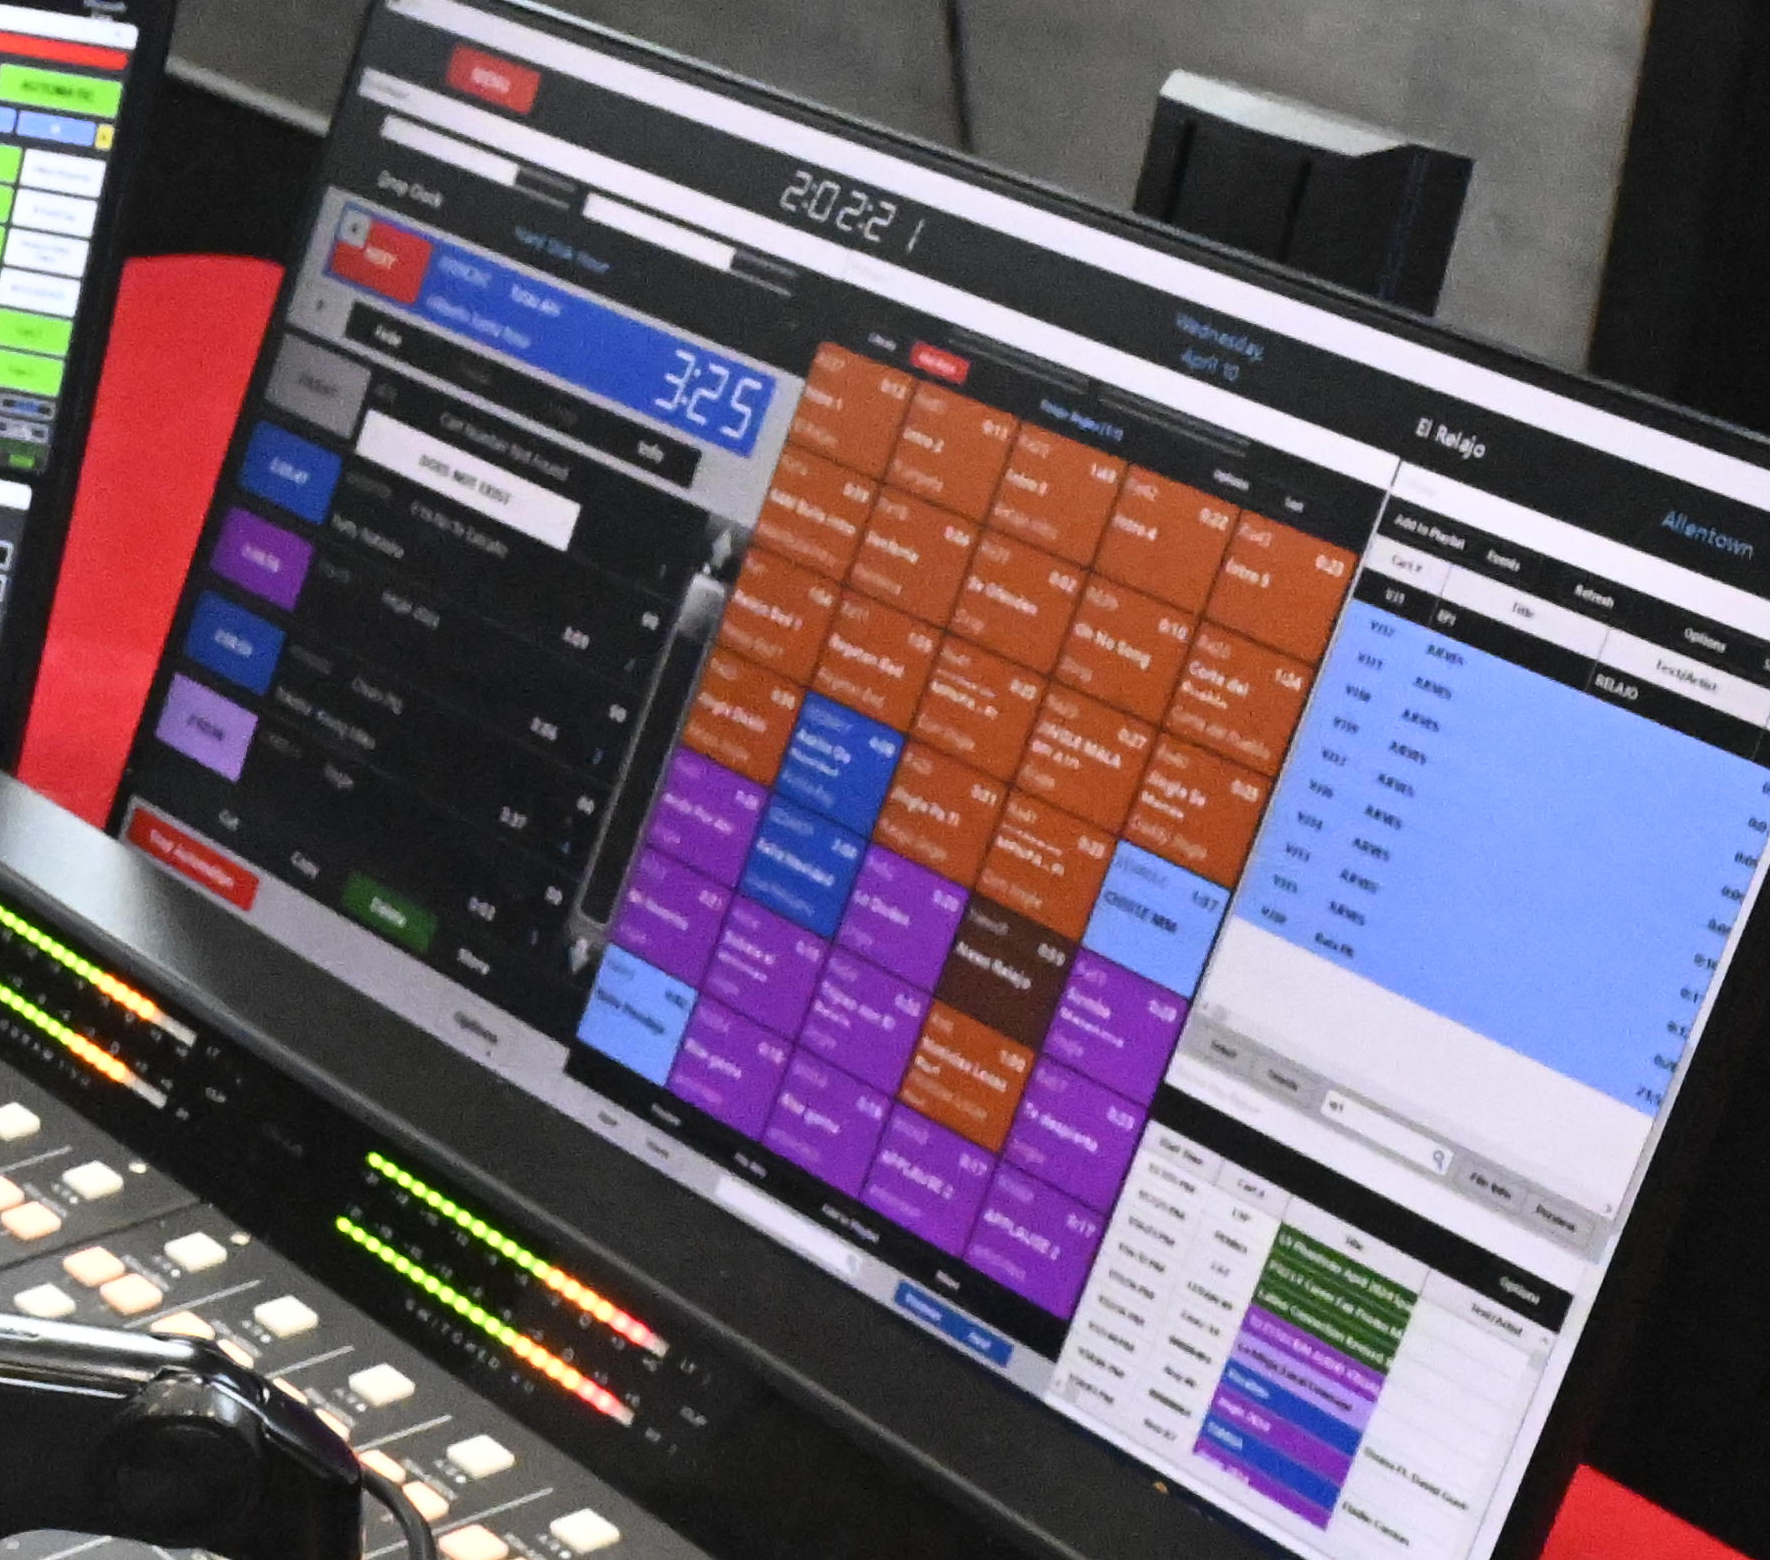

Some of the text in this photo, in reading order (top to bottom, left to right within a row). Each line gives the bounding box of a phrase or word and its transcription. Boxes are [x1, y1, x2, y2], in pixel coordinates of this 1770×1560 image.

[1177, 344, 1220, 378] April
[652, 344, 764, 445] 3:25
[1413, 415, 1489, 463] El Relajo
[450, 467, 478, 492] NOT
[1659, 506, 1758, 563] Allentown
[1681, 624, 1729, 656] Options
